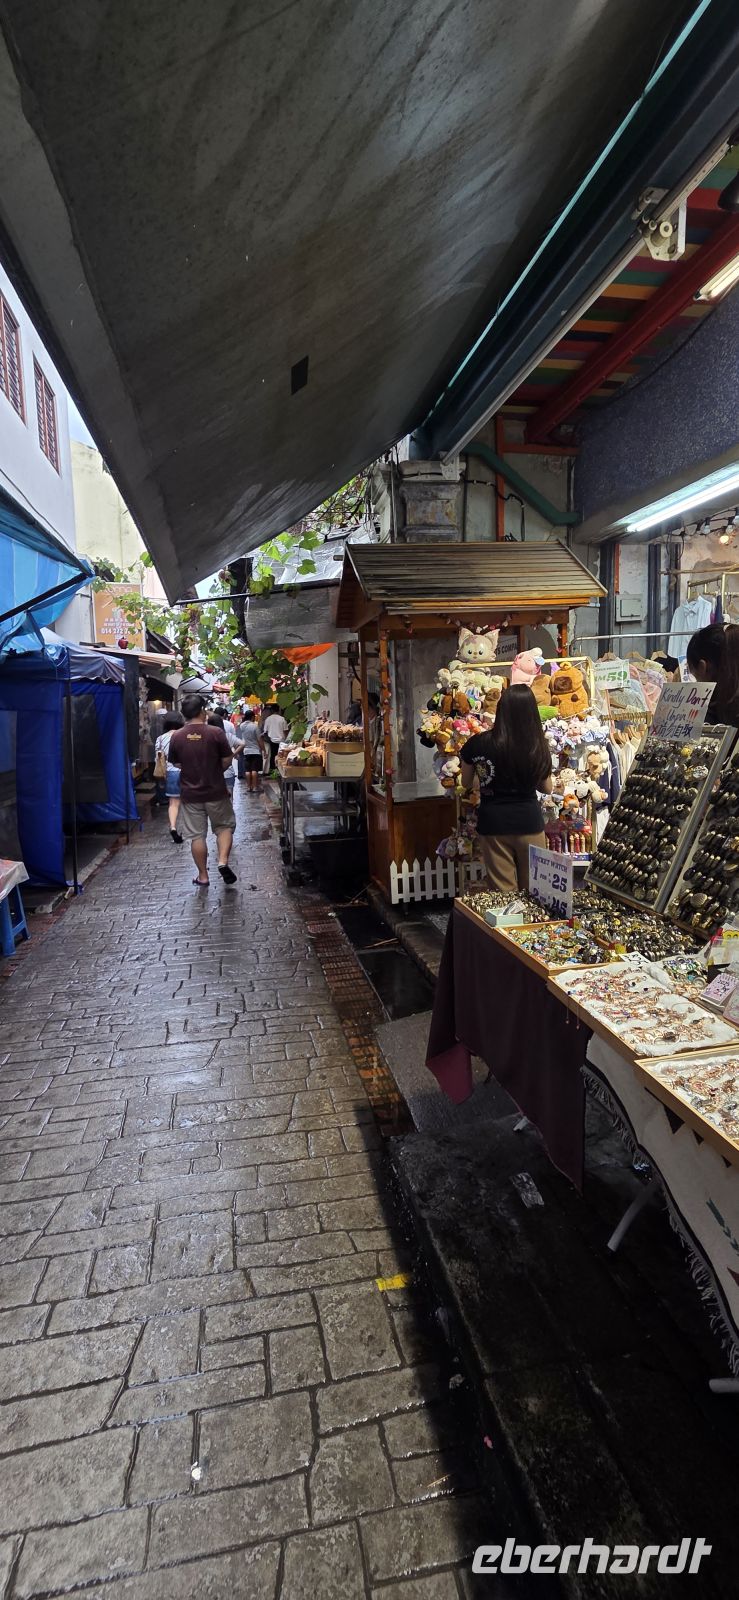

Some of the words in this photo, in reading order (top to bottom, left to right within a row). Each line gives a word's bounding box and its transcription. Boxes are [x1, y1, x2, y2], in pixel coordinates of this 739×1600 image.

[662, 687, 685, 709] Kindly
[686, 688, 712, 708] Don't
[551, 860, 568, 873] WATCH
[552, 873, 568, 893] 25
